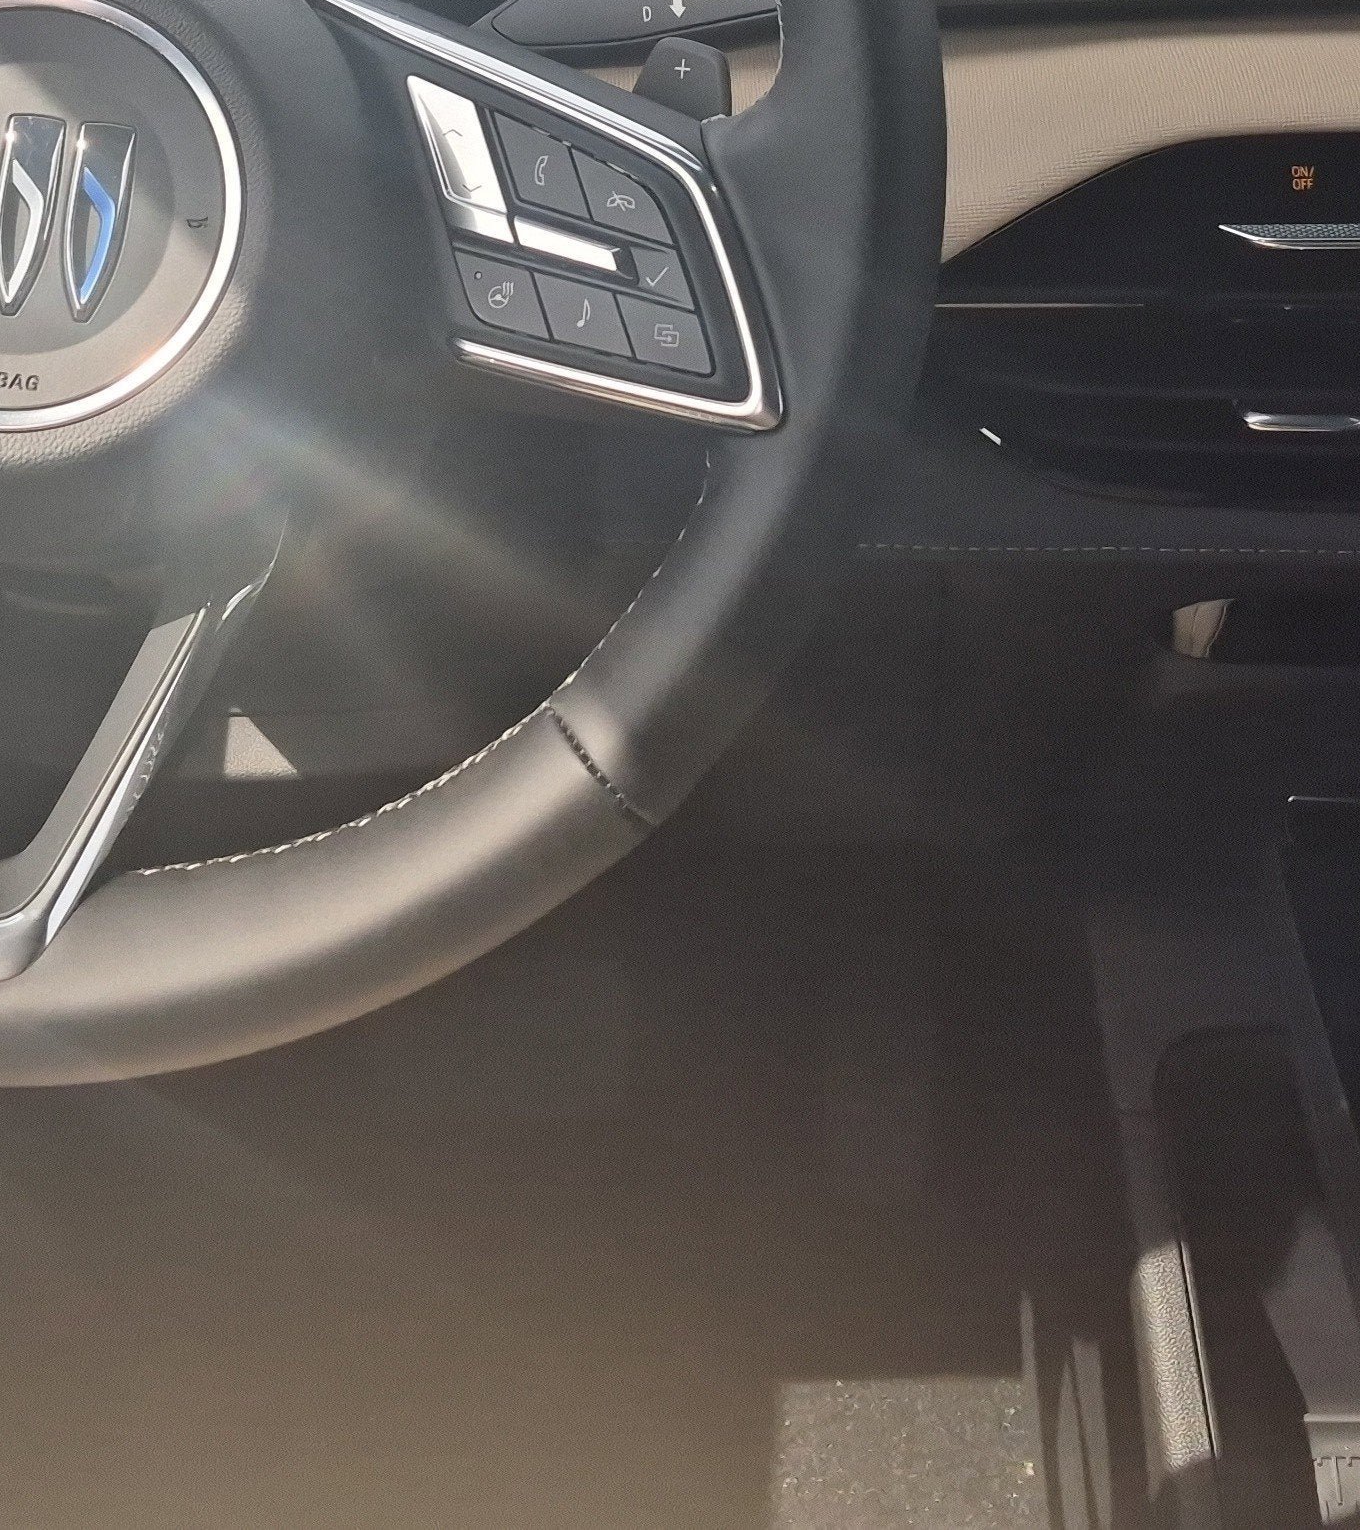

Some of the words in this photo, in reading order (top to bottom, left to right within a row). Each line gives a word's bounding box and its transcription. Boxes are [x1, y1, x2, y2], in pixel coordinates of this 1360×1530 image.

[643, 6, 652, 22] D
[1291, 166, 1315, 178] ON/
[1292, 178, 1314, 191] OFF
